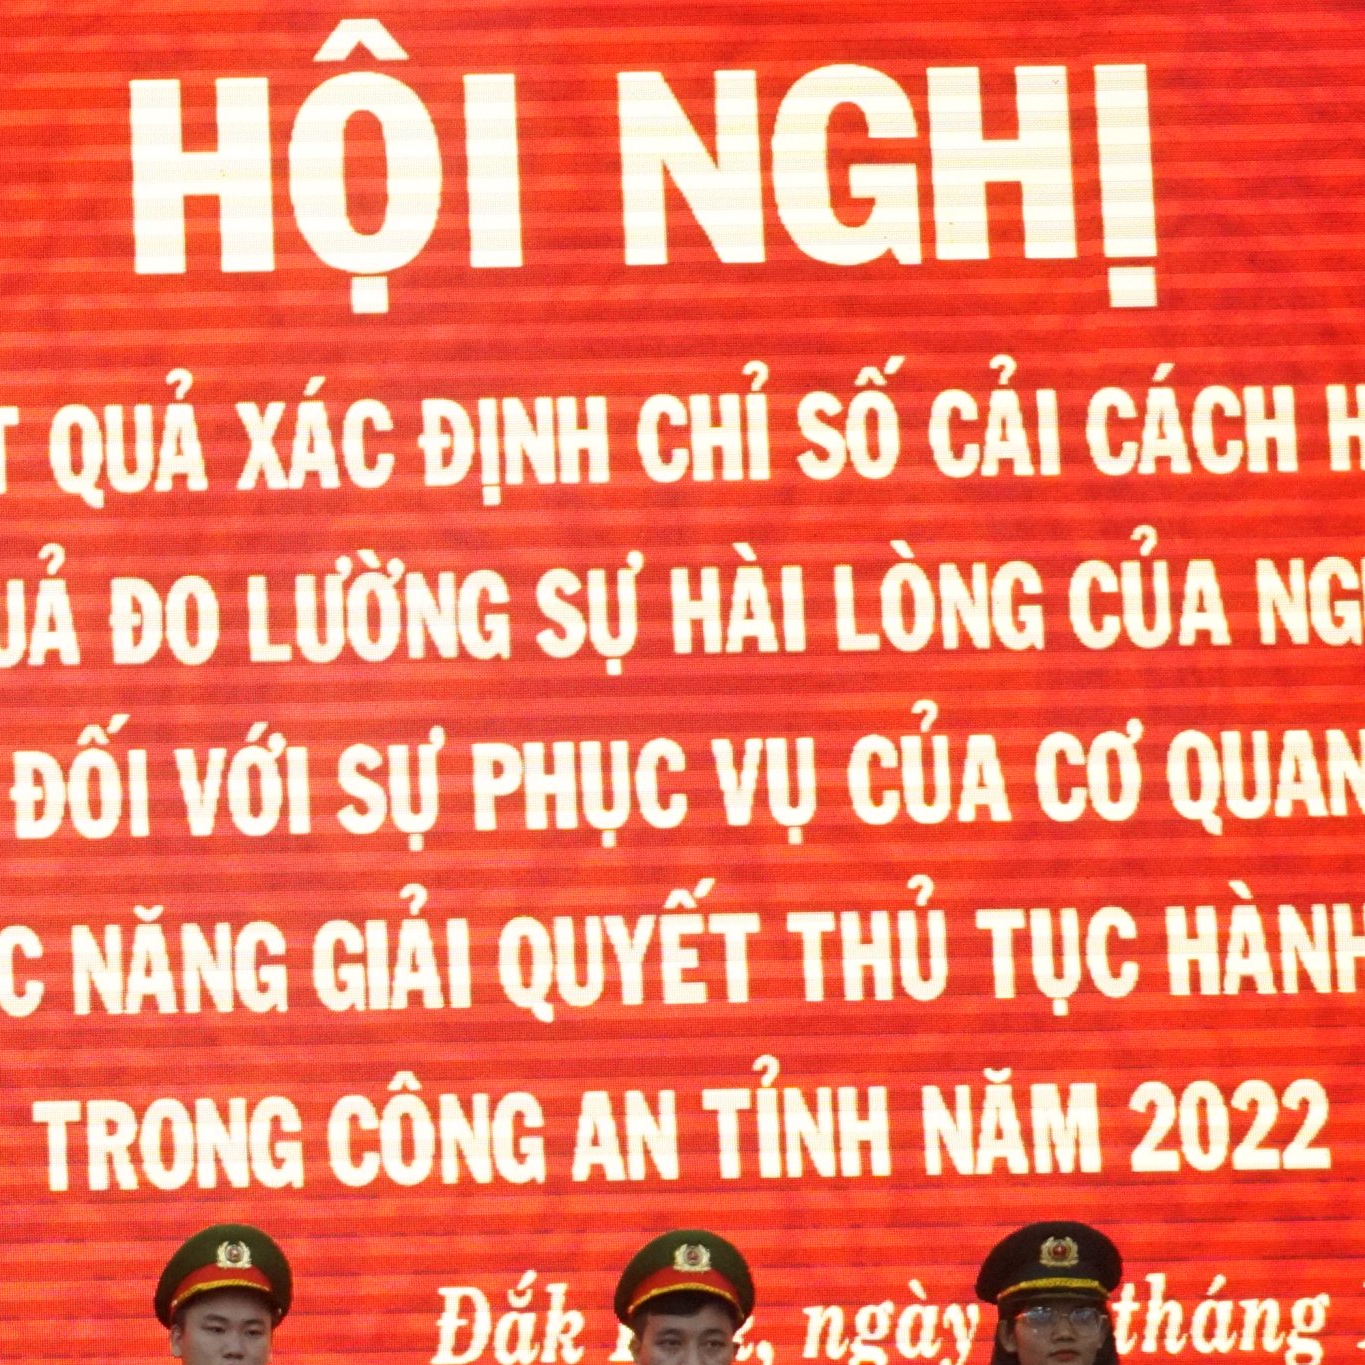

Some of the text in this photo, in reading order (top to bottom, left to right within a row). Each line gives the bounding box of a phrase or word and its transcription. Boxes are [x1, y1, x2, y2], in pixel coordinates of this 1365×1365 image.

[129, 19, 1157, 314] HỘI NGHỊ
[49, 368, 208, 509] QUẢ
[235, 376, 395, 490] XÁC
[418, 396, 610, 506] ĐỊNH
[637, 360, 770, 483] CHỈ
[797, 356, 904, 480] SỐ
[928, 355, 1060, 478] CẢI
[1086, 363, 1298, 475] CÁCH
[109, 576, 220, 665] ĐO
[247, 549, 511, 663] LƯỜNG
[535, 550, 643, 676] SỰ
[670, 543, 806, 654] HÀI
[834, 540, 1044, 651] LÒNG
[1069, 525, 1230, 649] CỦA
[1256, 557, 1365, 645] NG
[9, 714, 150, 839] ĐỐI
[173, 722, 311, 836] VỚI
[336, 726, 445, 852] SỰ
[470, 738, 687, 848] PHỤC
[711, 737, 816, 845] VỤ
[847, 700, 1011, 825] CỦA
[1035, 719, 1143, 822] CƠ
[1167, 729, 1365, 835] QUAN
[71, 905, 288, 1015] NĂNG
[312, 884, 471, 1012] GIẢI
[497, 878, 760, 1023] QUYẾT
[787, 875, 948, 1002] THỦ
[976, 907, 1138, 1016] TỤC
[1165, 880, 1365, 995] HÀNH
[32, 1055, 1331, 1191] TRONG CÔNG AN TỈNH NĂM 2022
[429, 1269, 585, 1365] Đắk
